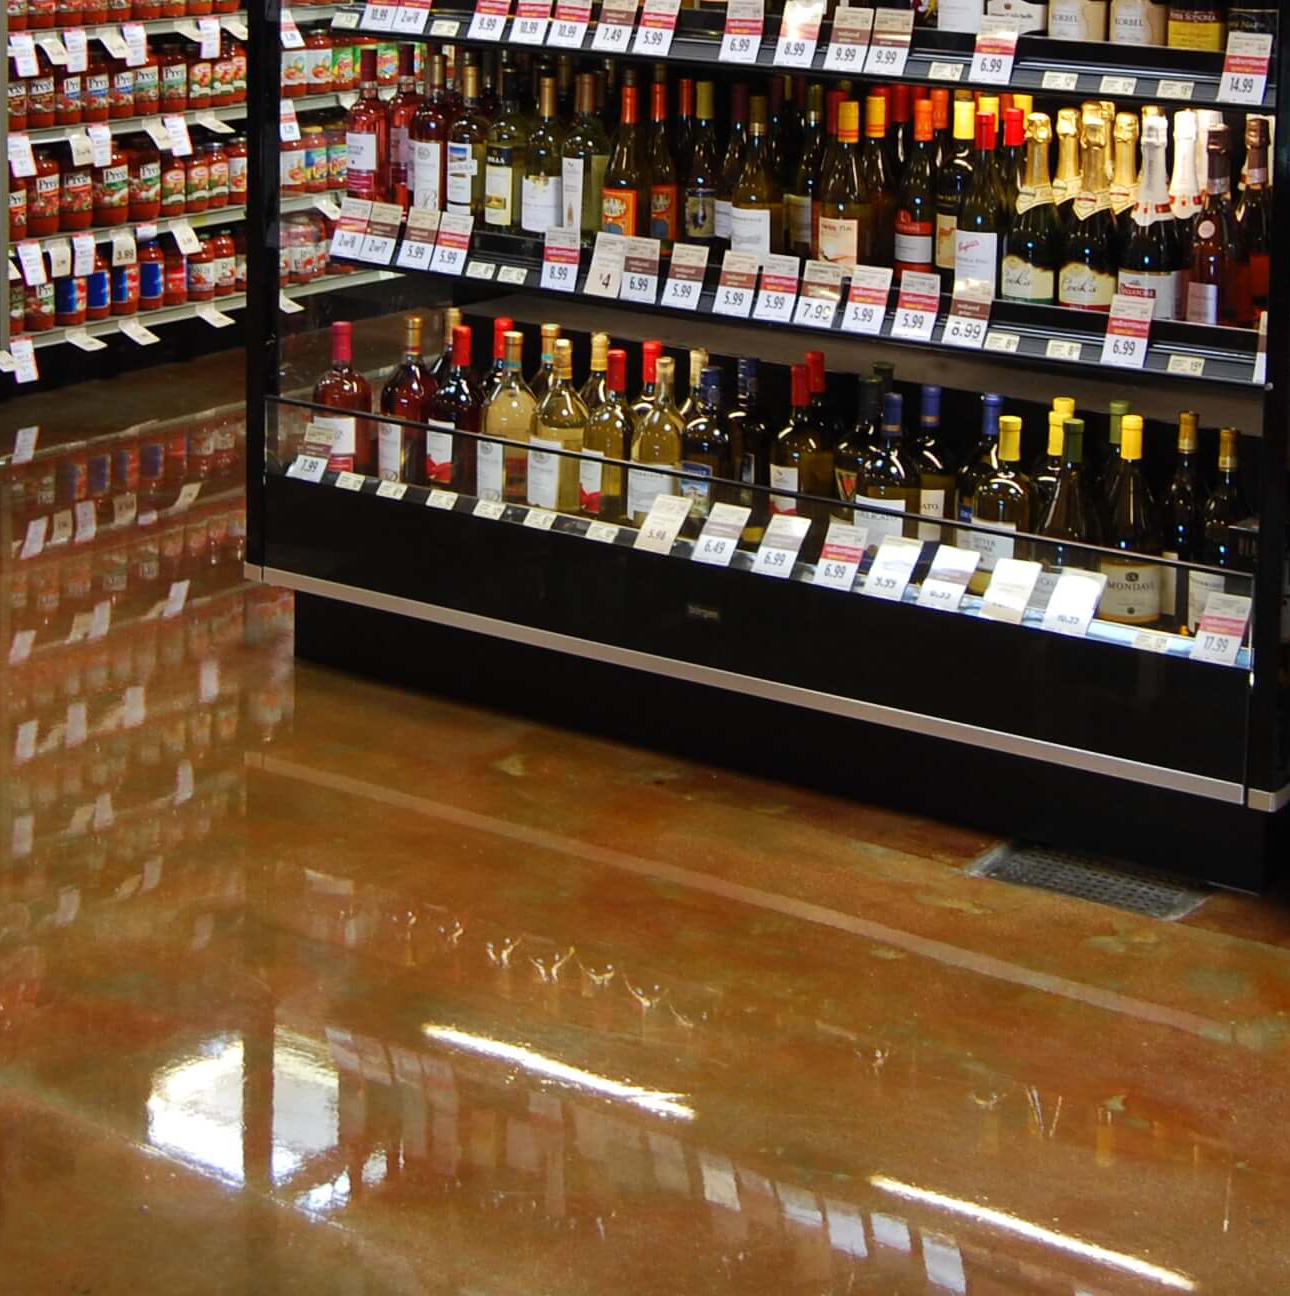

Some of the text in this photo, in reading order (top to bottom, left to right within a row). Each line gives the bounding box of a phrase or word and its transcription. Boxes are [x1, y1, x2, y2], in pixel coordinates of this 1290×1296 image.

[875, 50, 897, 65] 9.99
[979, 57, 1002, 73] 6.99
[1229, 78, 1254, 94] 14.99
[901, 313, 923, 329] 5.99
[1112, 340, 1135, 357] 6.99
